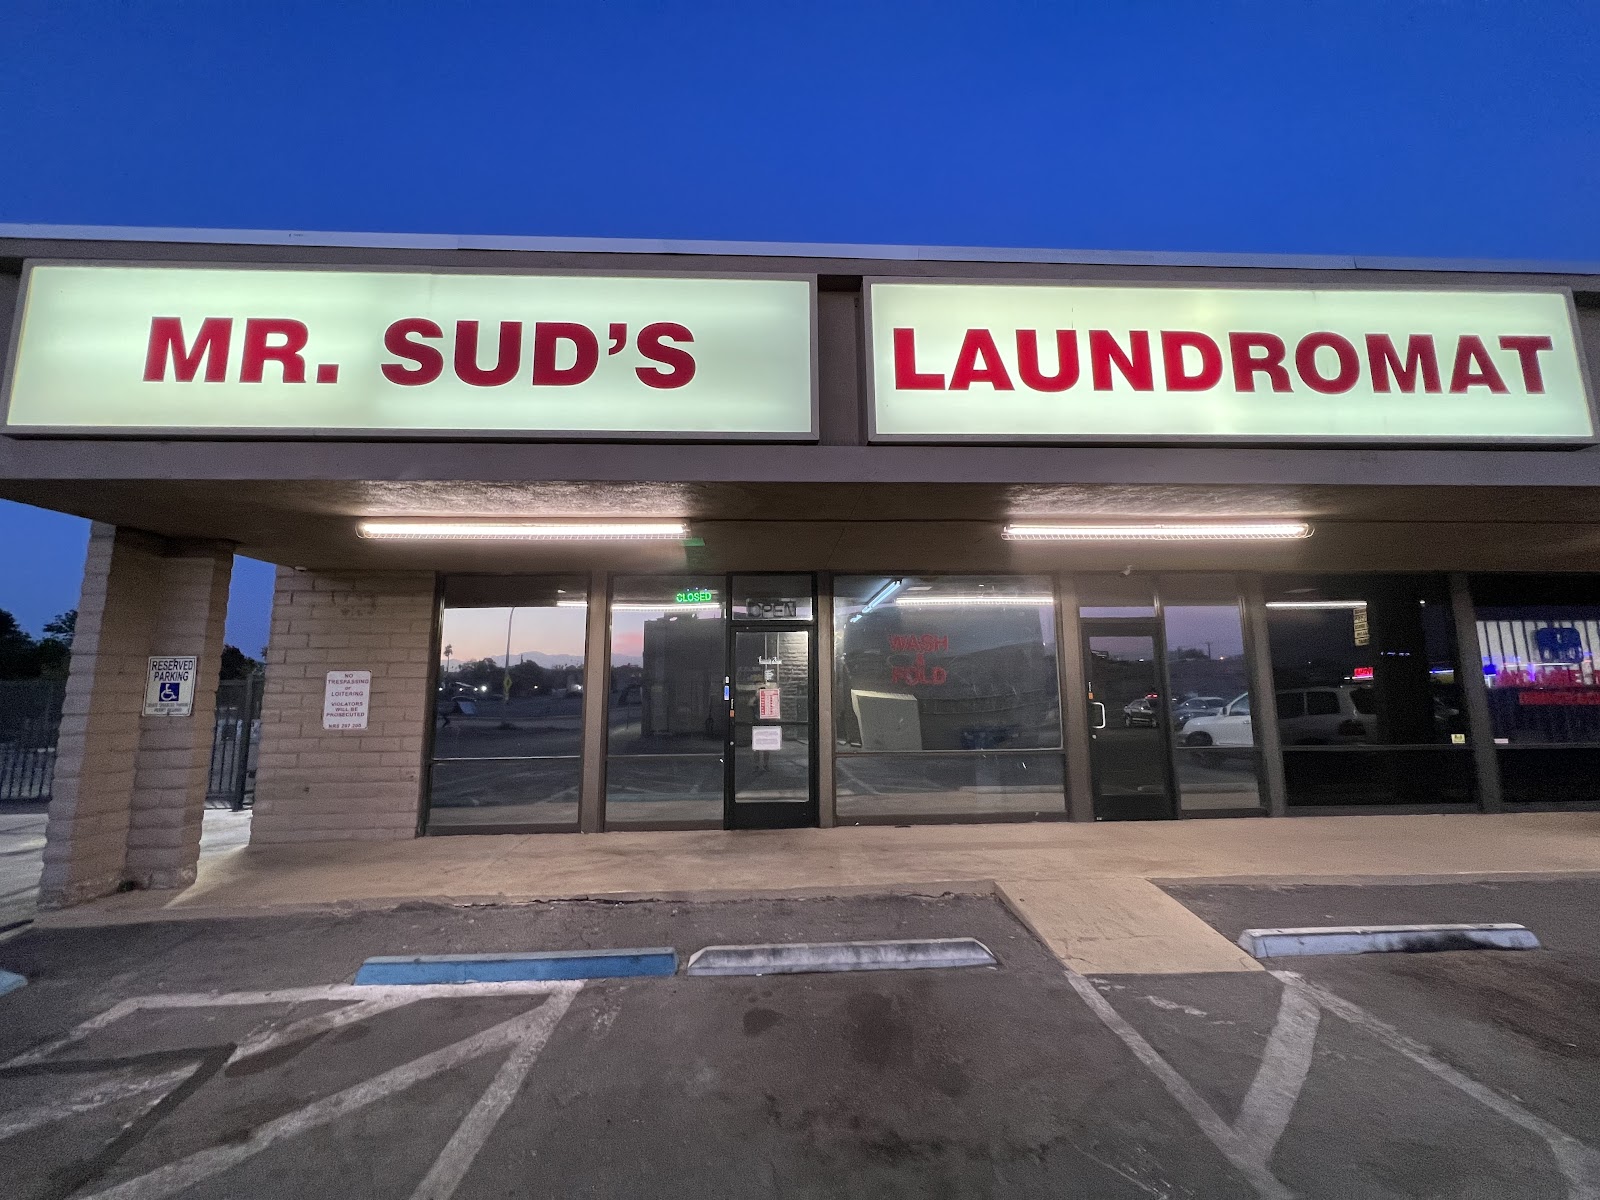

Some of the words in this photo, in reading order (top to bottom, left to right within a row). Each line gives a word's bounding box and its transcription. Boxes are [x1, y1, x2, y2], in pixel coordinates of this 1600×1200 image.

[142, 316, 340, 385] MR.
[380, 317, 697, 390] SUD'S
[892, 327, 1554, 395] LAUNDROMAT
[676, 592, 712, 603] CLOSED
[748, 603, 796, 618] OPEN
[889, 633, 949, 652] WASH
[151, 660, 193, 671] RESERVED
[154, 671, 189, 681] PARKING
[891, 666, 947, 686] FOLD
